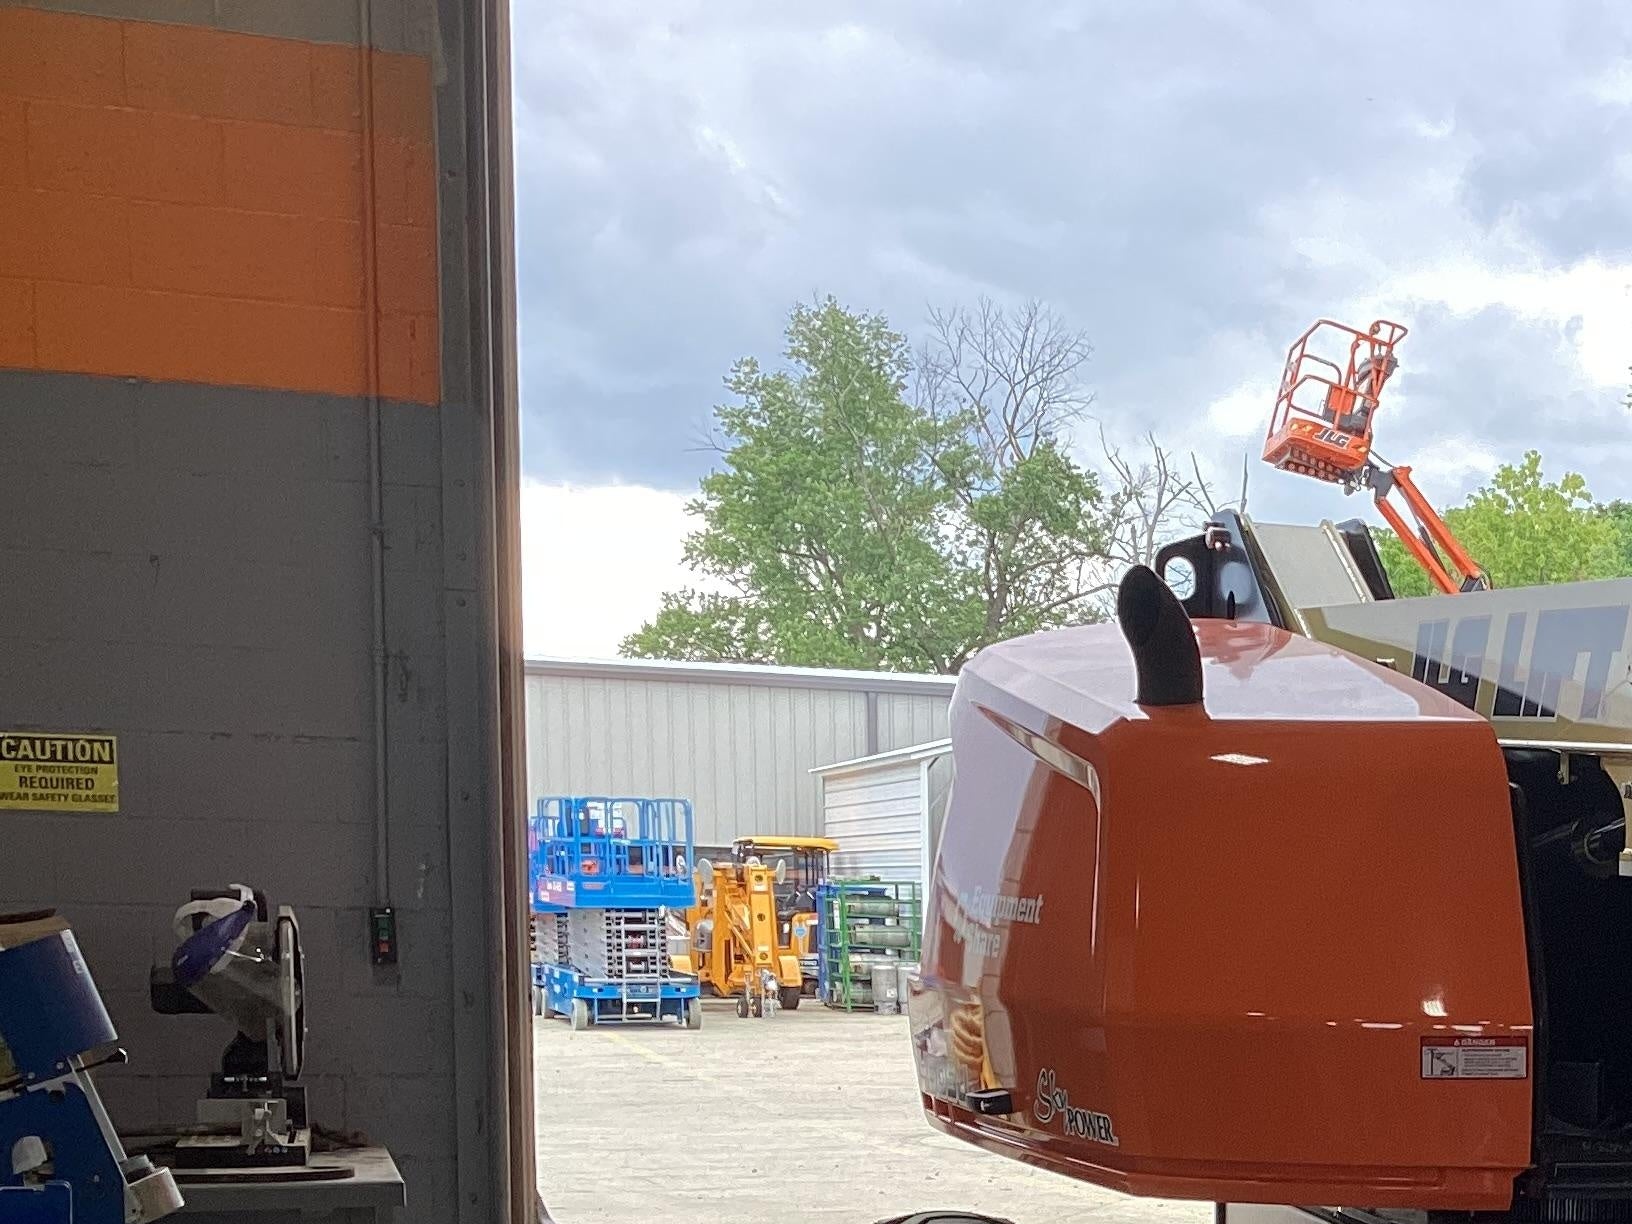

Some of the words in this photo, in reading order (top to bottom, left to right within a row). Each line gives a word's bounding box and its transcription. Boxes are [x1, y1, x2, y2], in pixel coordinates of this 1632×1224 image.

[1312, 428, 1351, 449] JLG
[1492, 604, 1630, 719] LIFT
[1, 739, 111, 761] CAUTION
[14, 764, 33, 773] EYE
[36, 765, 98, 775] PROTECTION
[18, 775, 95, 791] REQUIRED
[0, 791, 30, 801] WEAR
[31, 792, 69, 802] SAFETY
[1065, 1107, 1119, 1146] POWER
